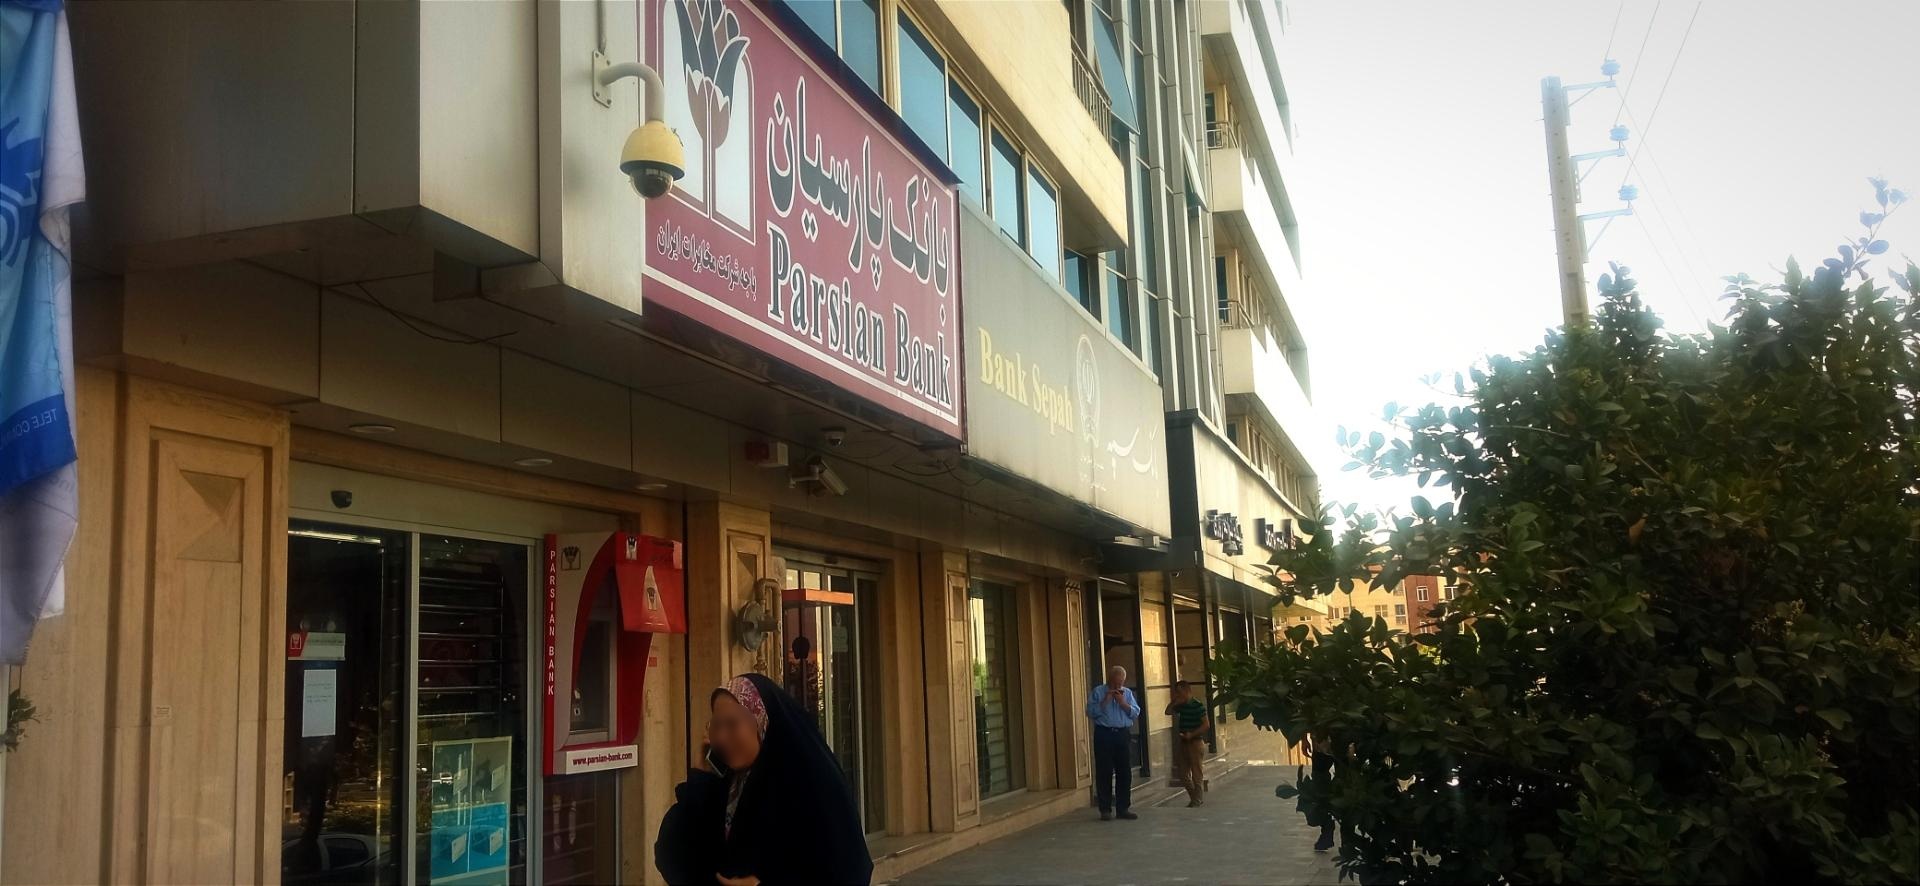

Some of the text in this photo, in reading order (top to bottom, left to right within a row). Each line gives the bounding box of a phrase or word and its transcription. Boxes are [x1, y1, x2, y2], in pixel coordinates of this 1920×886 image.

[656, 218, 681, 262] ایران
[766, 75, 950, 327] بانک پارسیان
[766, 220, 953, 411] Parsian Bank
[978, 326, 1075, 436] Bank Sepah
[547, 550, 556, 696] PARSIAN BANK
[572, 752, 633, 766] www.parsian-bank.com
